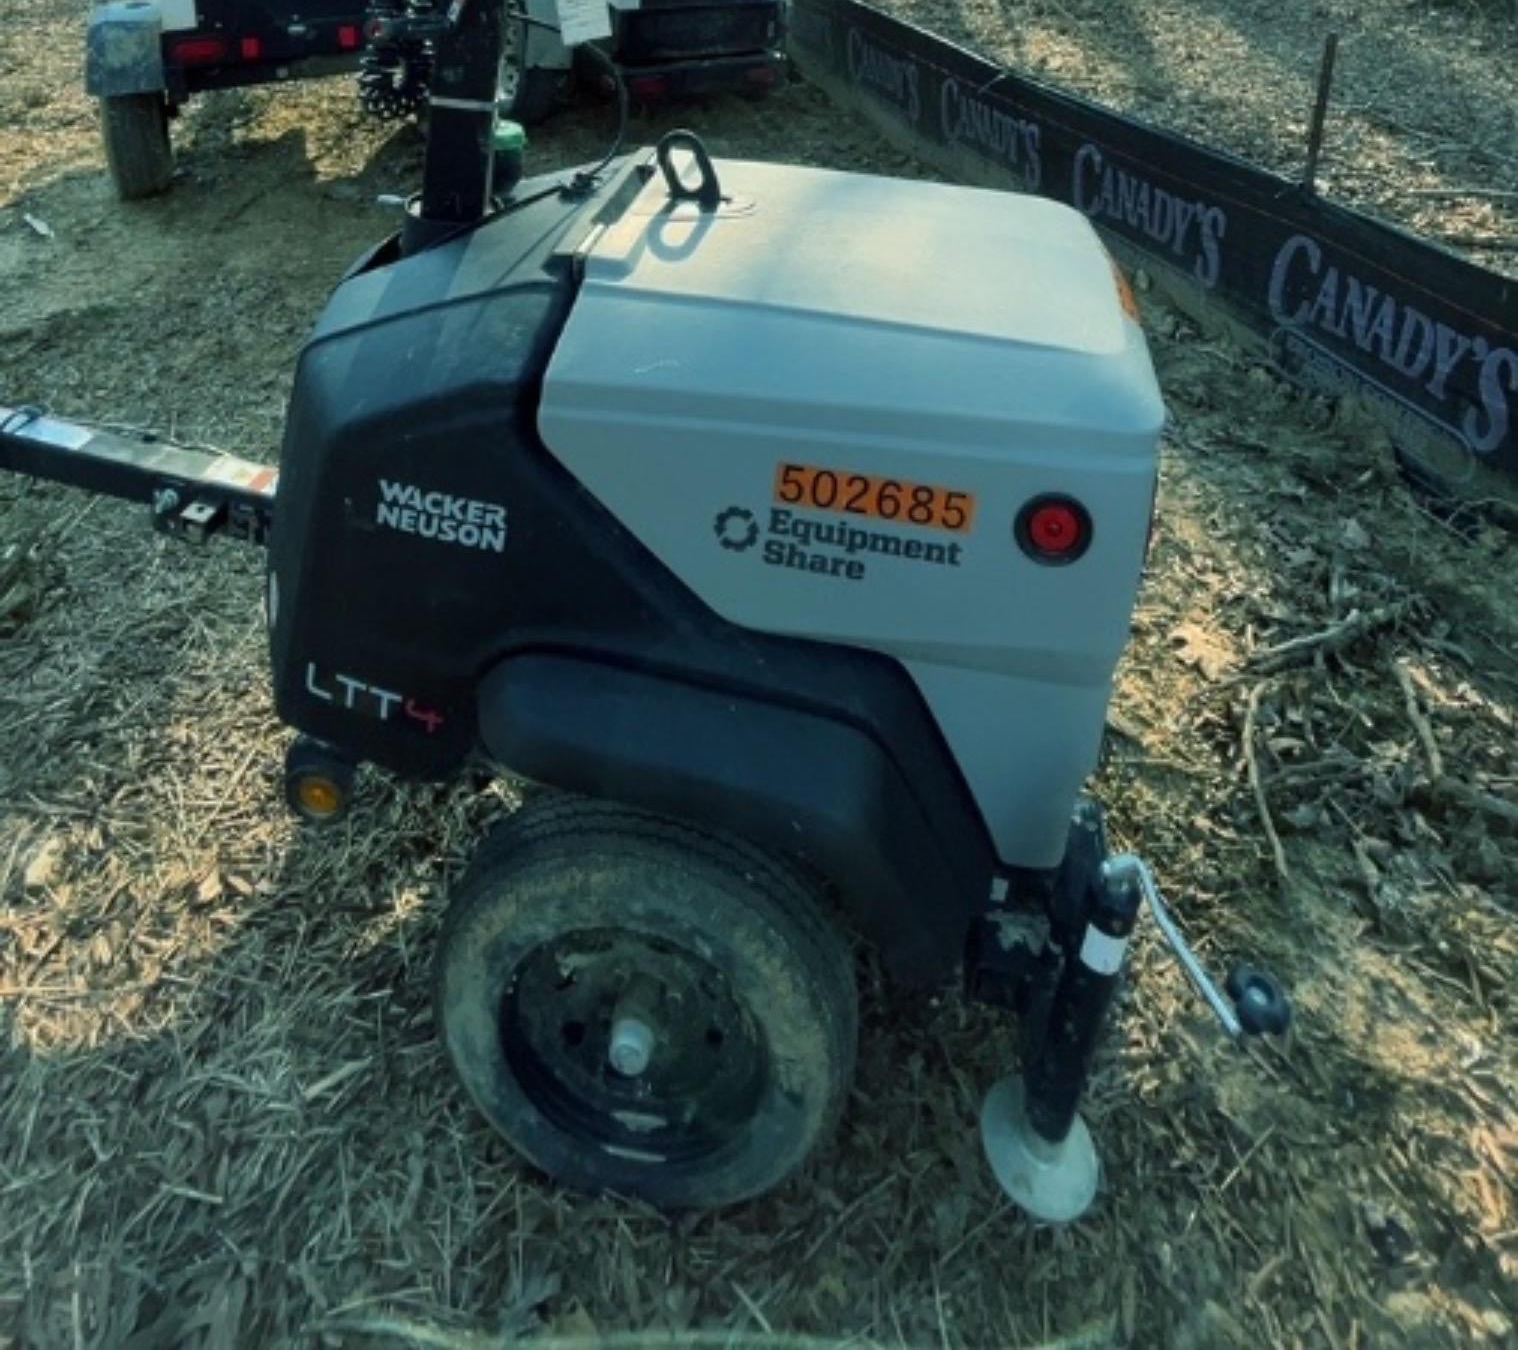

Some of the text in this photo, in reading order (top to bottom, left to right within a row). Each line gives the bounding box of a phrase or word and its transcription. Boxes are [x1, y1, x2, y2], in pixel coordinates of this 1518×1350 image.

[1072, 142, 1228, 290] CANADY'S
[1268, 233, 1518, 454] CANADY'S
[378, 478, 507, 529] WACKER
[777, 463, 968, 530] 502685
[376, 503, 507, 553] NEUSON
[767, 506, 964, 567] Equipment
[762, 539, 865, 581] Share
